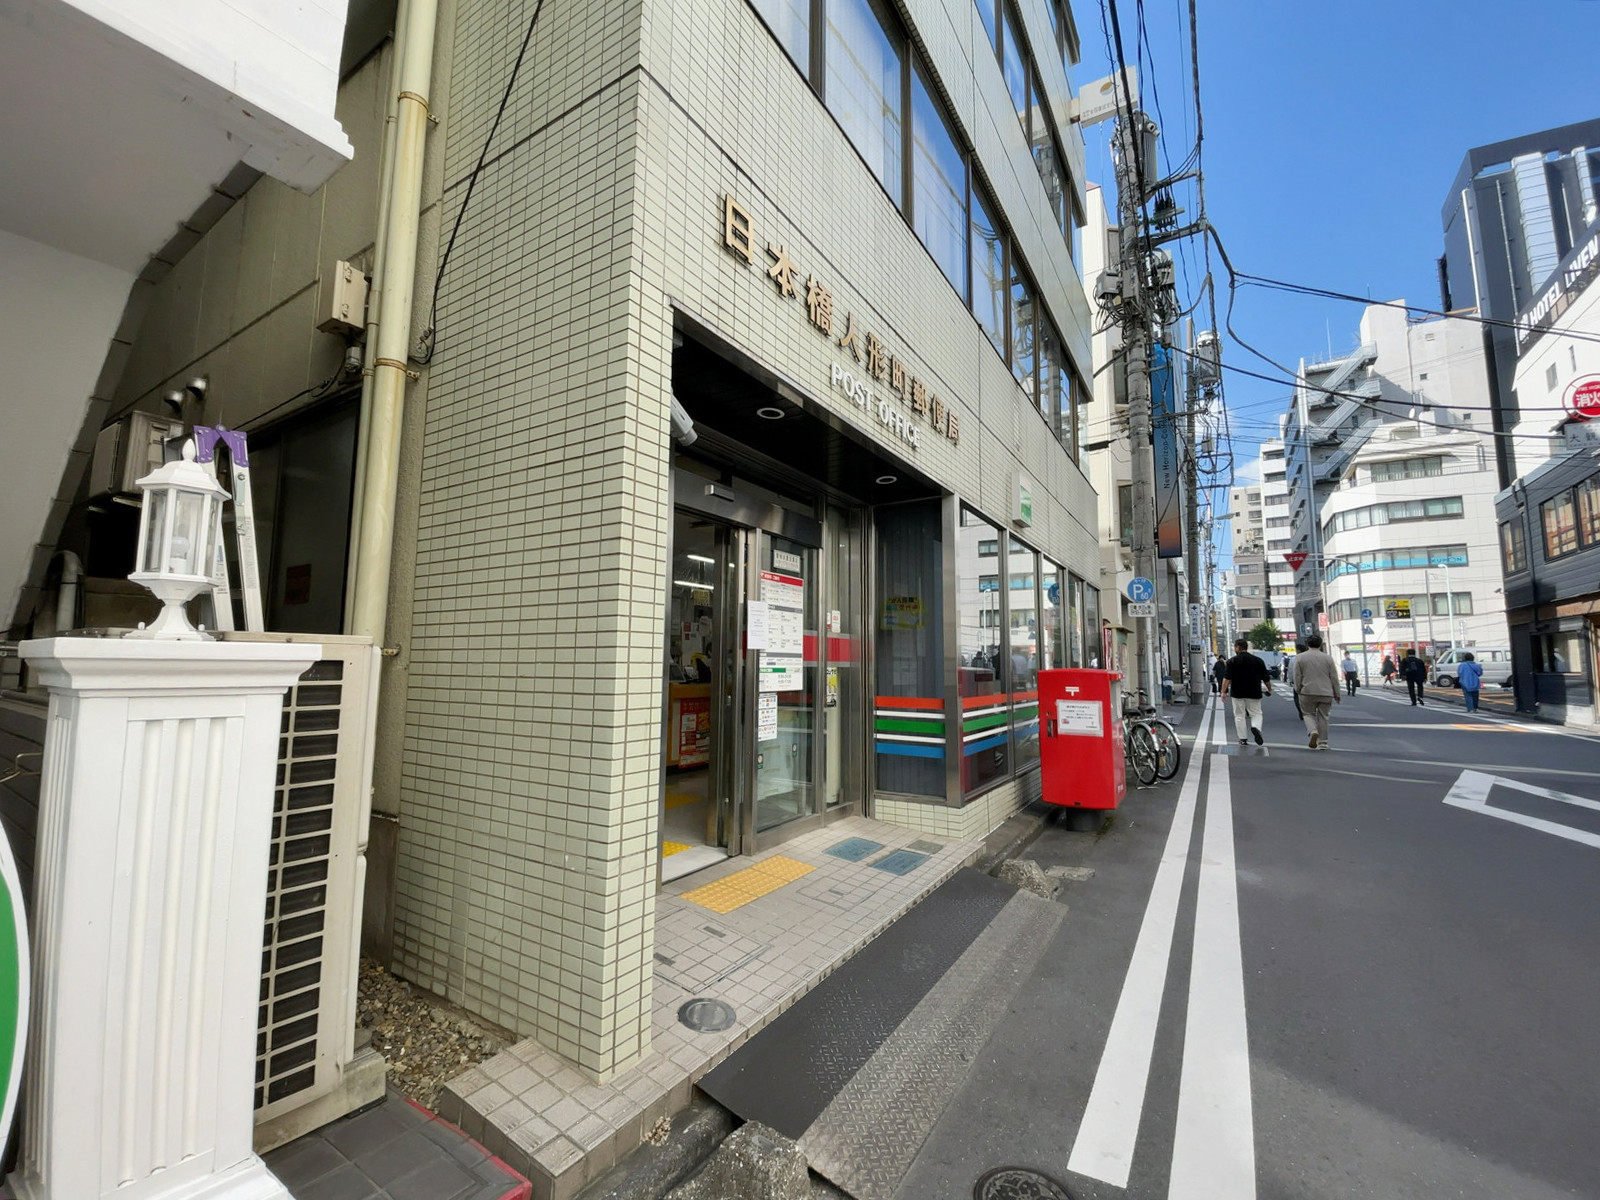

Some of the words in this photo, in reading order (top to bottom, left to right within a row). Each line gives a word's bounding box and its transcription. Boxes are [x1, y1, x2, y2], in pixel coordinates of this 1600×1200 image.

[725, 193, 960, 446] 日本橋人形町郵便局
[1530, 281, 1563, 326] HOTEL
[831, 361, 873, 412] POST
[879, 401, 920, 448] OFFICE
[1162, 440, 1170, 470] Horizon
[1133, 584, 1144, 600] P
